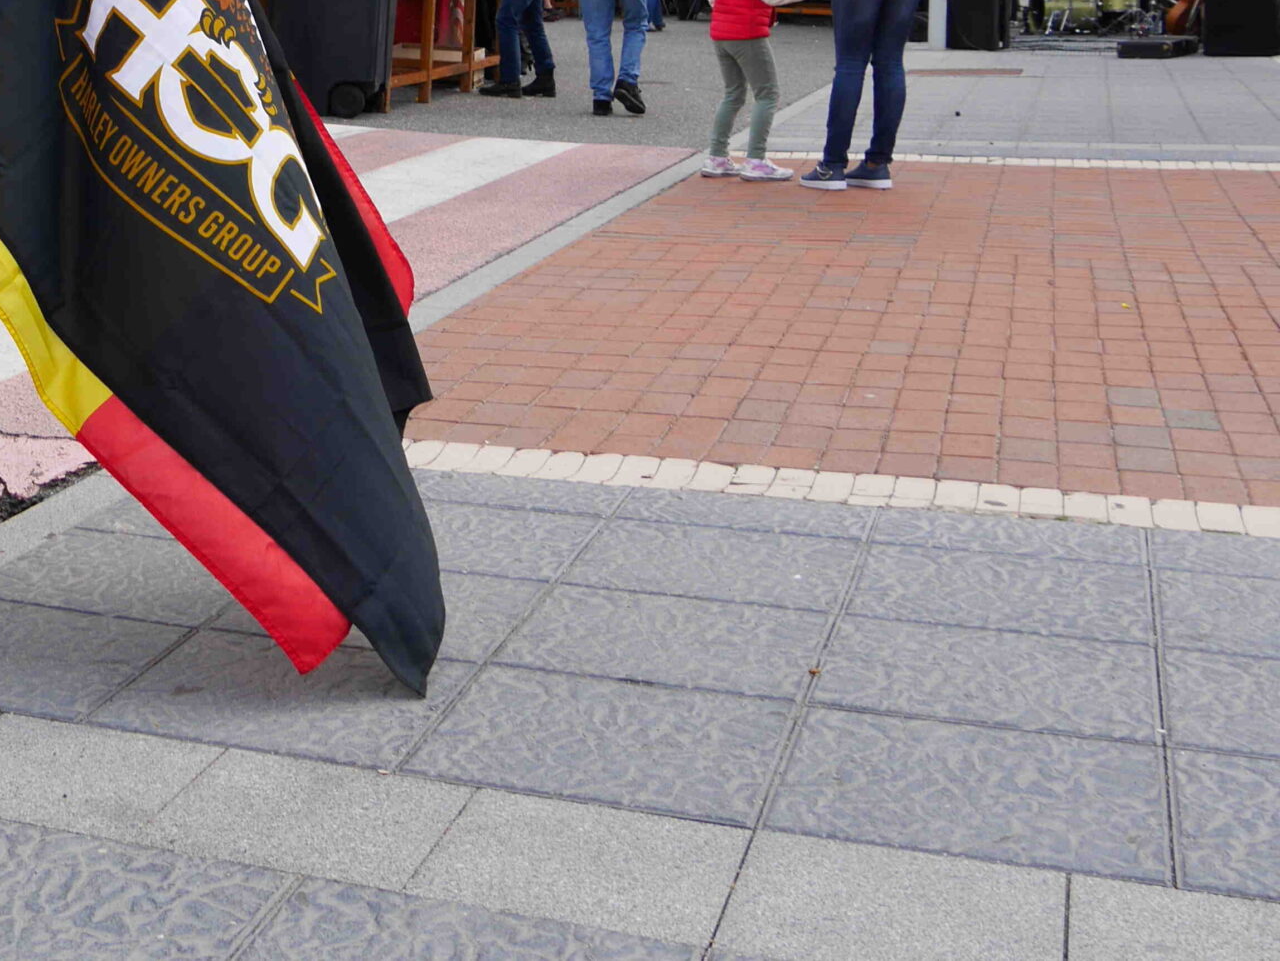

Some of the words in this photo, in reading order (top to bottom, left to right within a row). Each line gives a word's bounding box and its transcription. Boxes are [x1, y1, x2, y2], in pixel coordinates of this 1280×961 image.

[73, 69, 118, 150] HARLEY
[108, 135, 205, 225] OWNERS
[197, 208, 282, 279] GROUP
